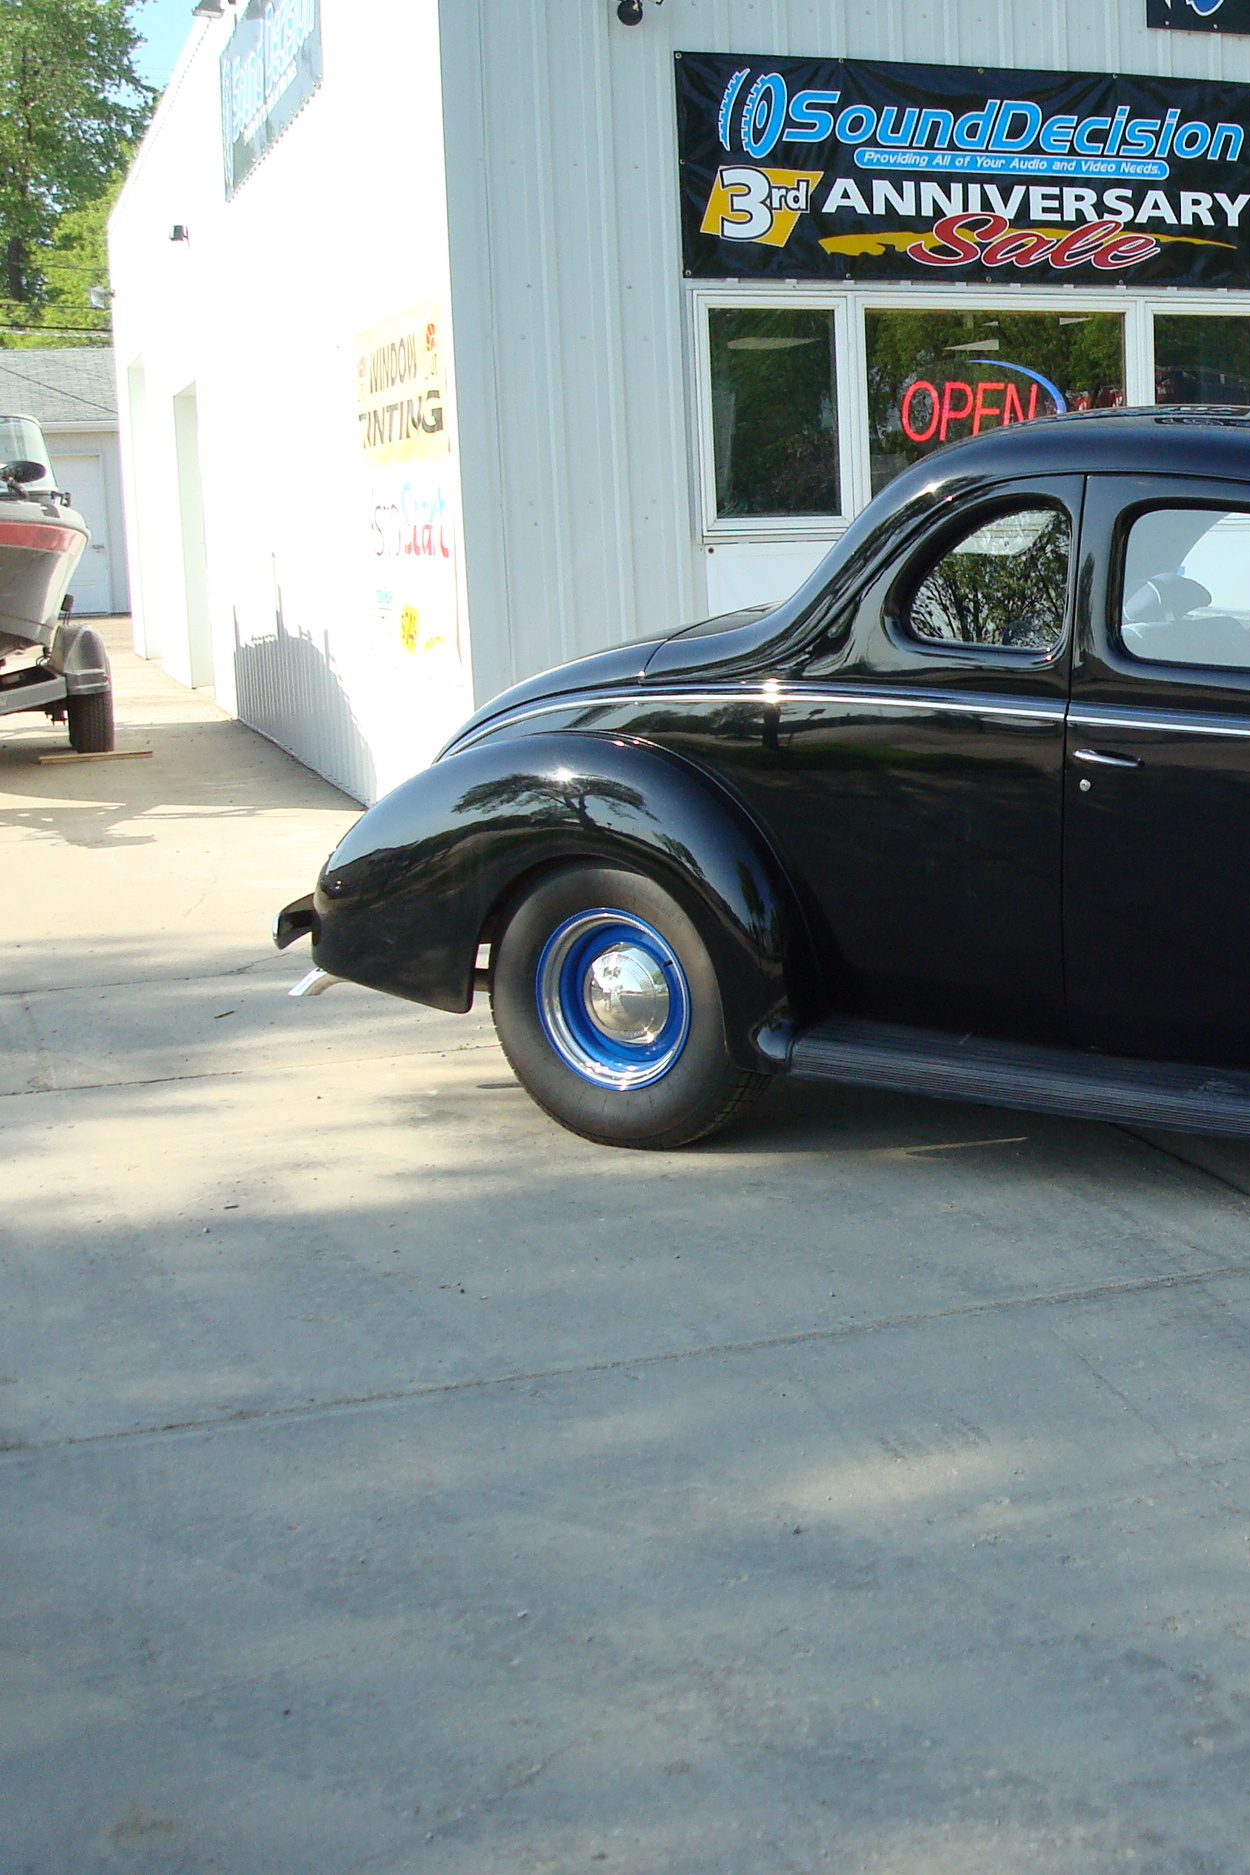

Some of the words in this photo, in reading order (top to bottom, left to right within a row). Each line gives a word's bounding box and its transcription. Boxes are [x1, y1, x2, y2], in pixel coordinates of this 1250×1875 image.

[863, 152, 928, 167] Providing
[932, 154, 950, 167] All
[955, 156, 970, 167] of
[976, 156, 1005, 168] Your
[1009, 158, 1047, 170] Audio
[1052, 160, 1075, 171] and
[1080, 161, 1115, 173] Video
[1120, 162, 1161, 174] Needs.
[718, 166, 808, 241] 3rd
[821, 177, 1250, 228] ANNIVERSARY
[907, 213, 1160, 269] Sale
[370, 332, 417, 394] WINDOW
[902, 380, 1038, 442] OPEN
